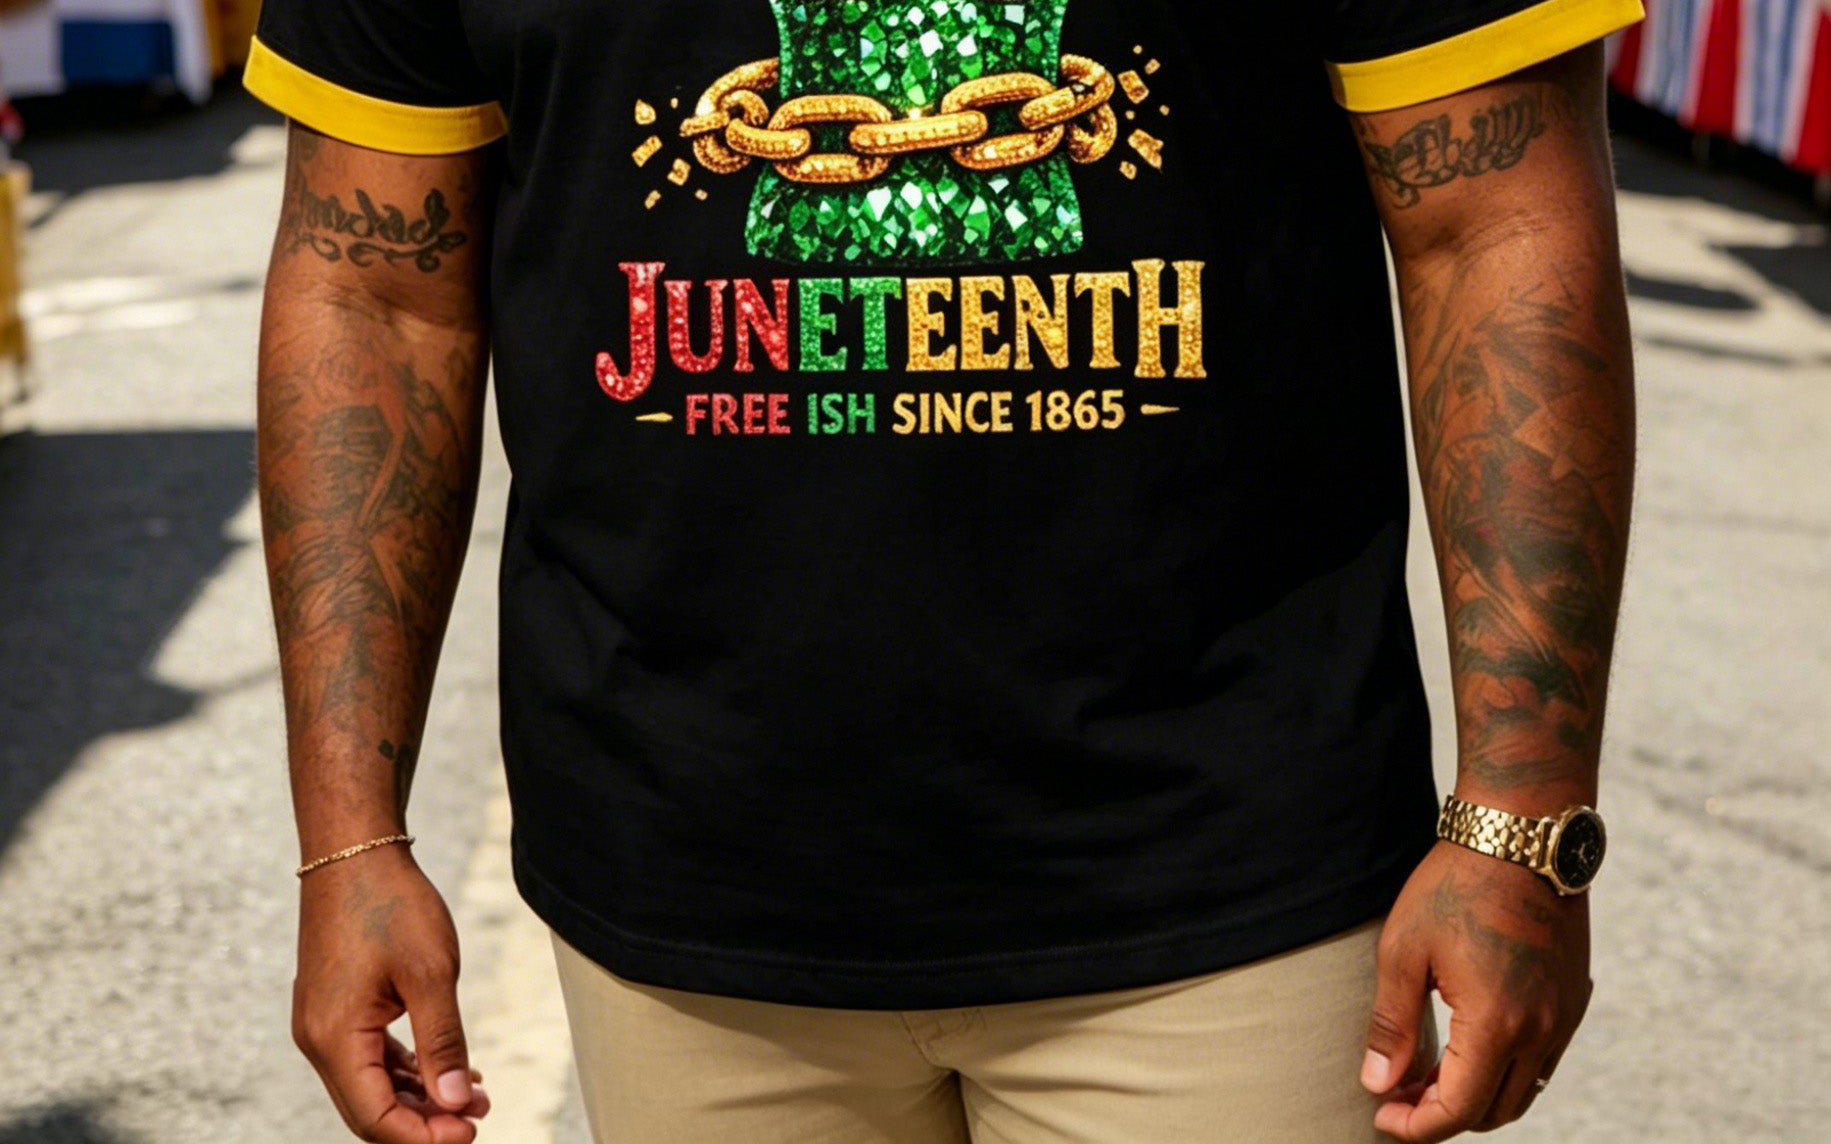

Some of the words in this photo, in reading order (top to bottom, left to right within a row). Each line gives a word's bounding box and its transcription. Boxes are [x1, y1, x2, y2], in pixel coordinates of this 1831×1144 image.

[595, 258, 1207, 402] JUNETEENTH
[686, 393, 791, 436] FREE
[808, 393, 876, 435] ISH
[892, 391, 1014, 435] SINCE
[1026, 389, 1126, 432] 1865
